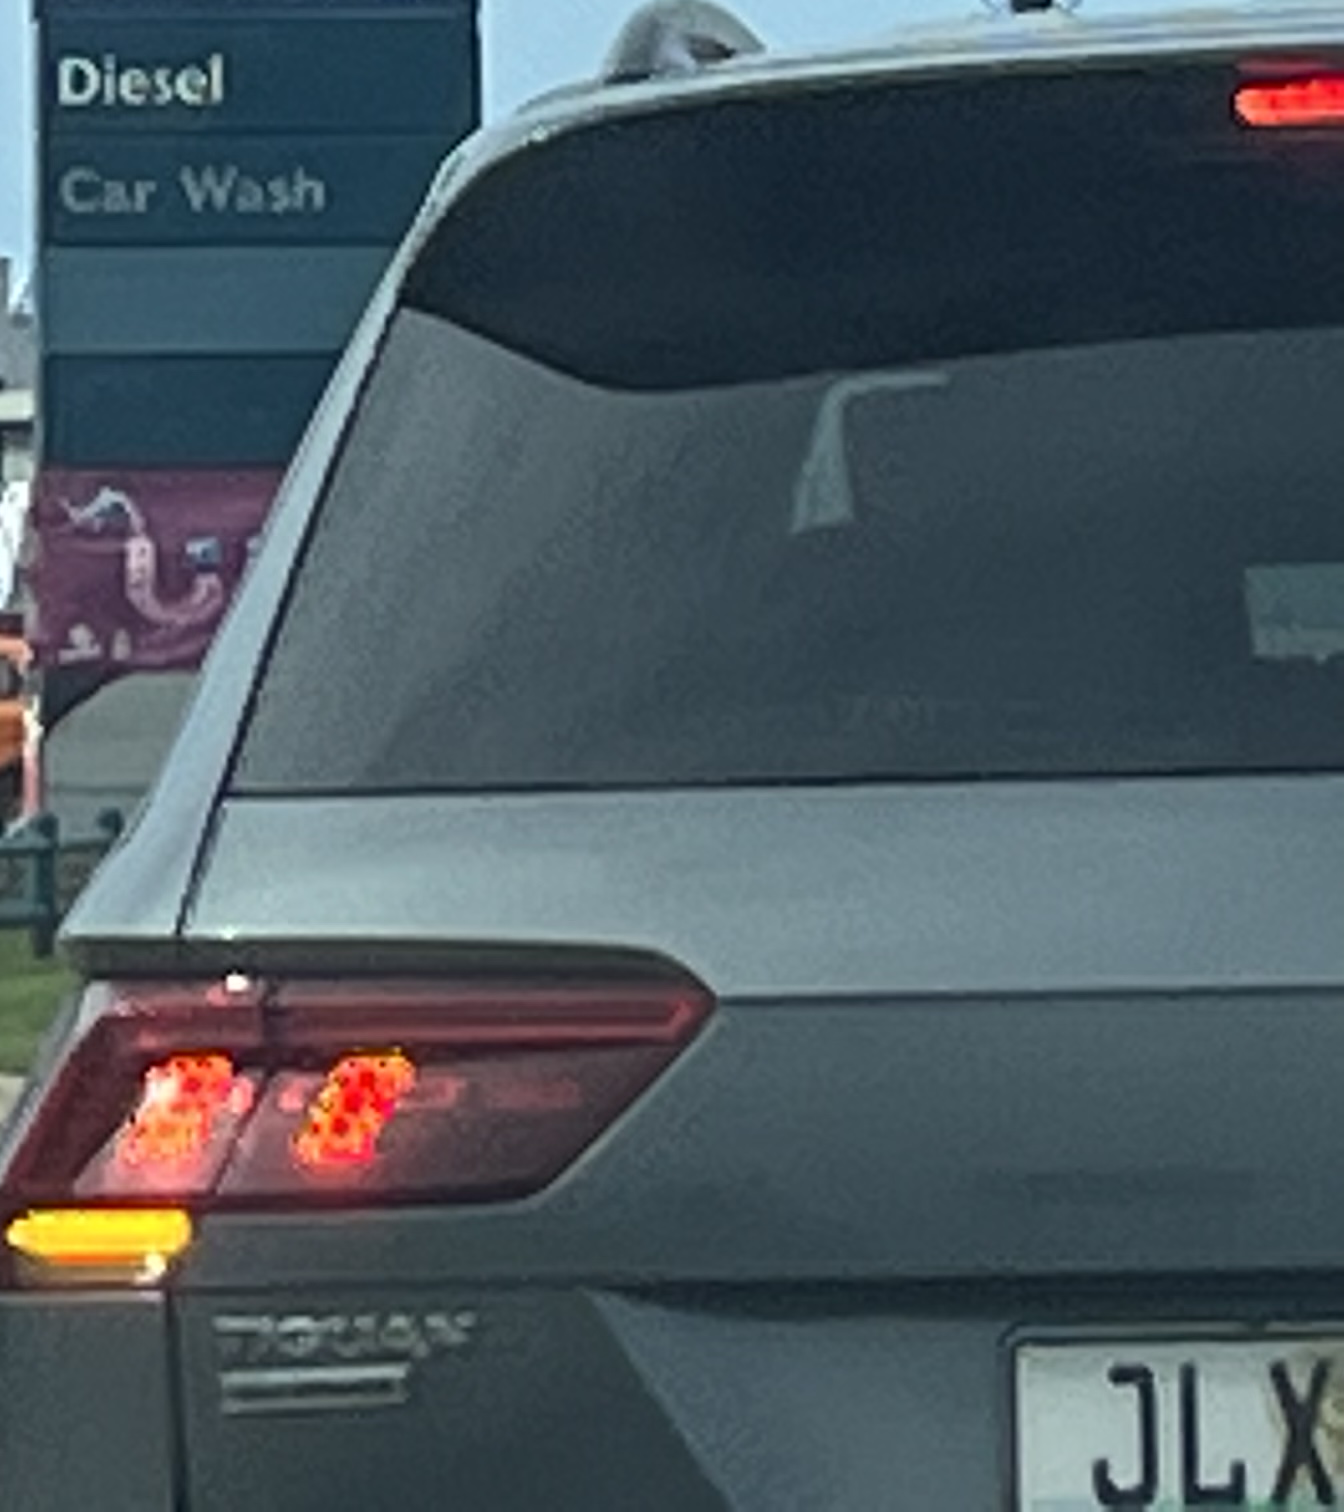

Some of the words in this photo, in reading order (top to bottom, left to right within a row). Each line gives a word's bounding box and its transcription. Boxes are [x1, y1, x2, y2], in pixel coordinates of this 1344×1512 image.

[57, 52, 224, 107] Diesel
[60, 165, 157, 213] Car
[179, 163, 326, 214] Wash
[1092, 1358, 1336, 1507] JLX
